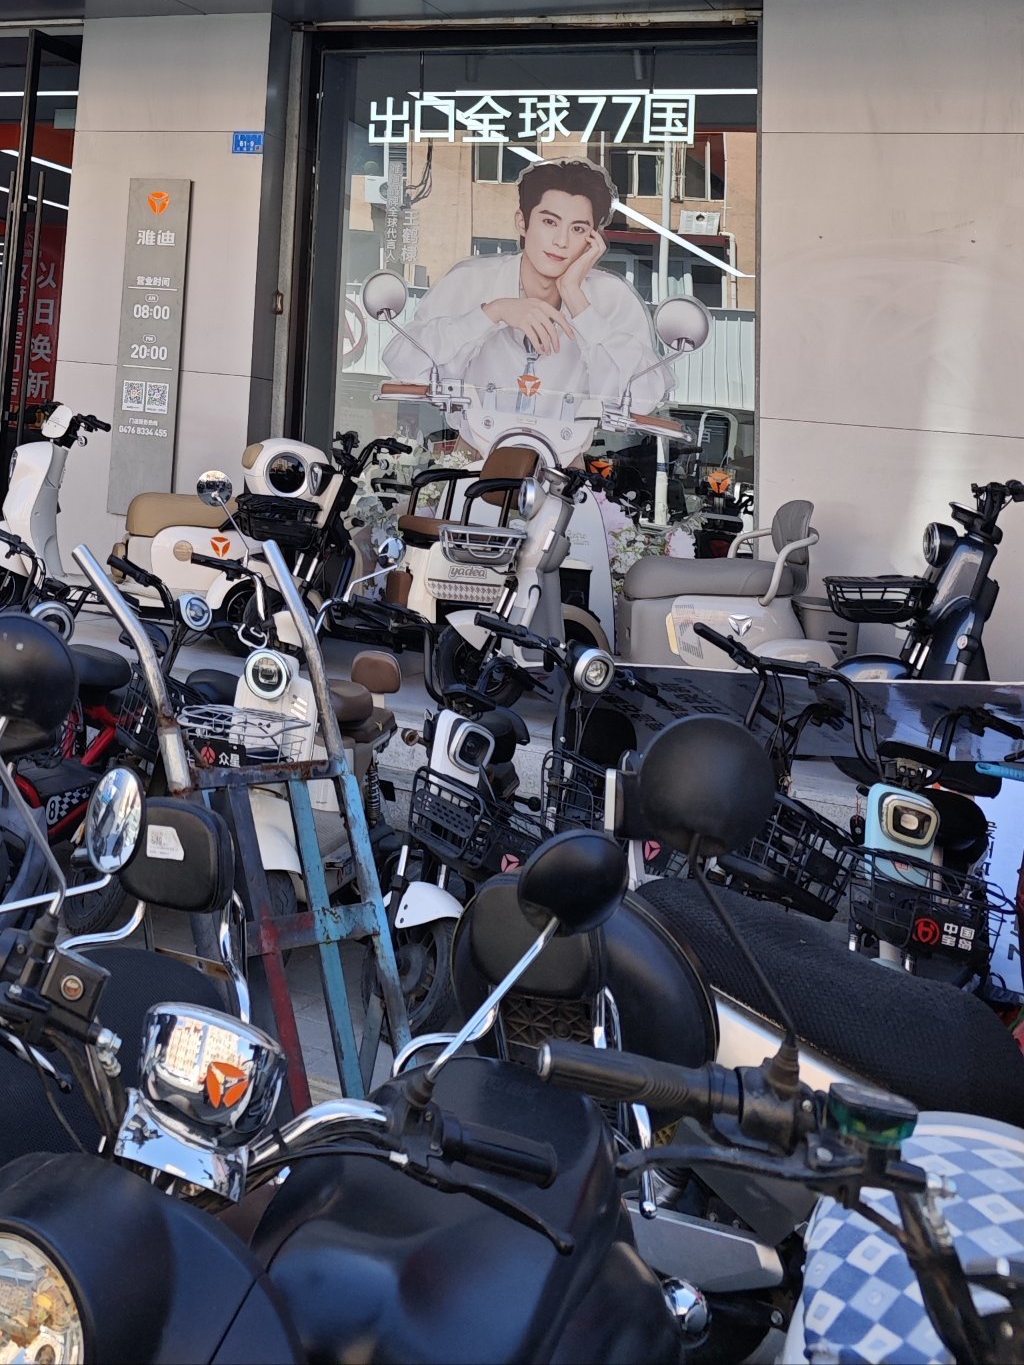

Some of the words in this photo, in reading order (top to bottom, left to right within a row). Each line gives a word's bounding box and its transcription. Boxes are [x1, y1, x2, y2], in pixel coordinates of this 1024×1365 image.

[369, 93, 696, 144] 出口全球77国
[136, 230, 176, 247] 雅迪
[136, 276, 170, 287] 营业时间
[133, 304, 170, 320] 08:00
[130, 344, 168, 361] 20:00
[118, 425, 136, 434] 0476
[136, 427, 154, 436] 8334
[154, 428, 168, 437] 455
[449, 565, 487, 579] yadea
[219, 752, 240, 768] 众星
[944, 922, 975, 940] 中国
[942, 935, 972, 951] 宝岛
